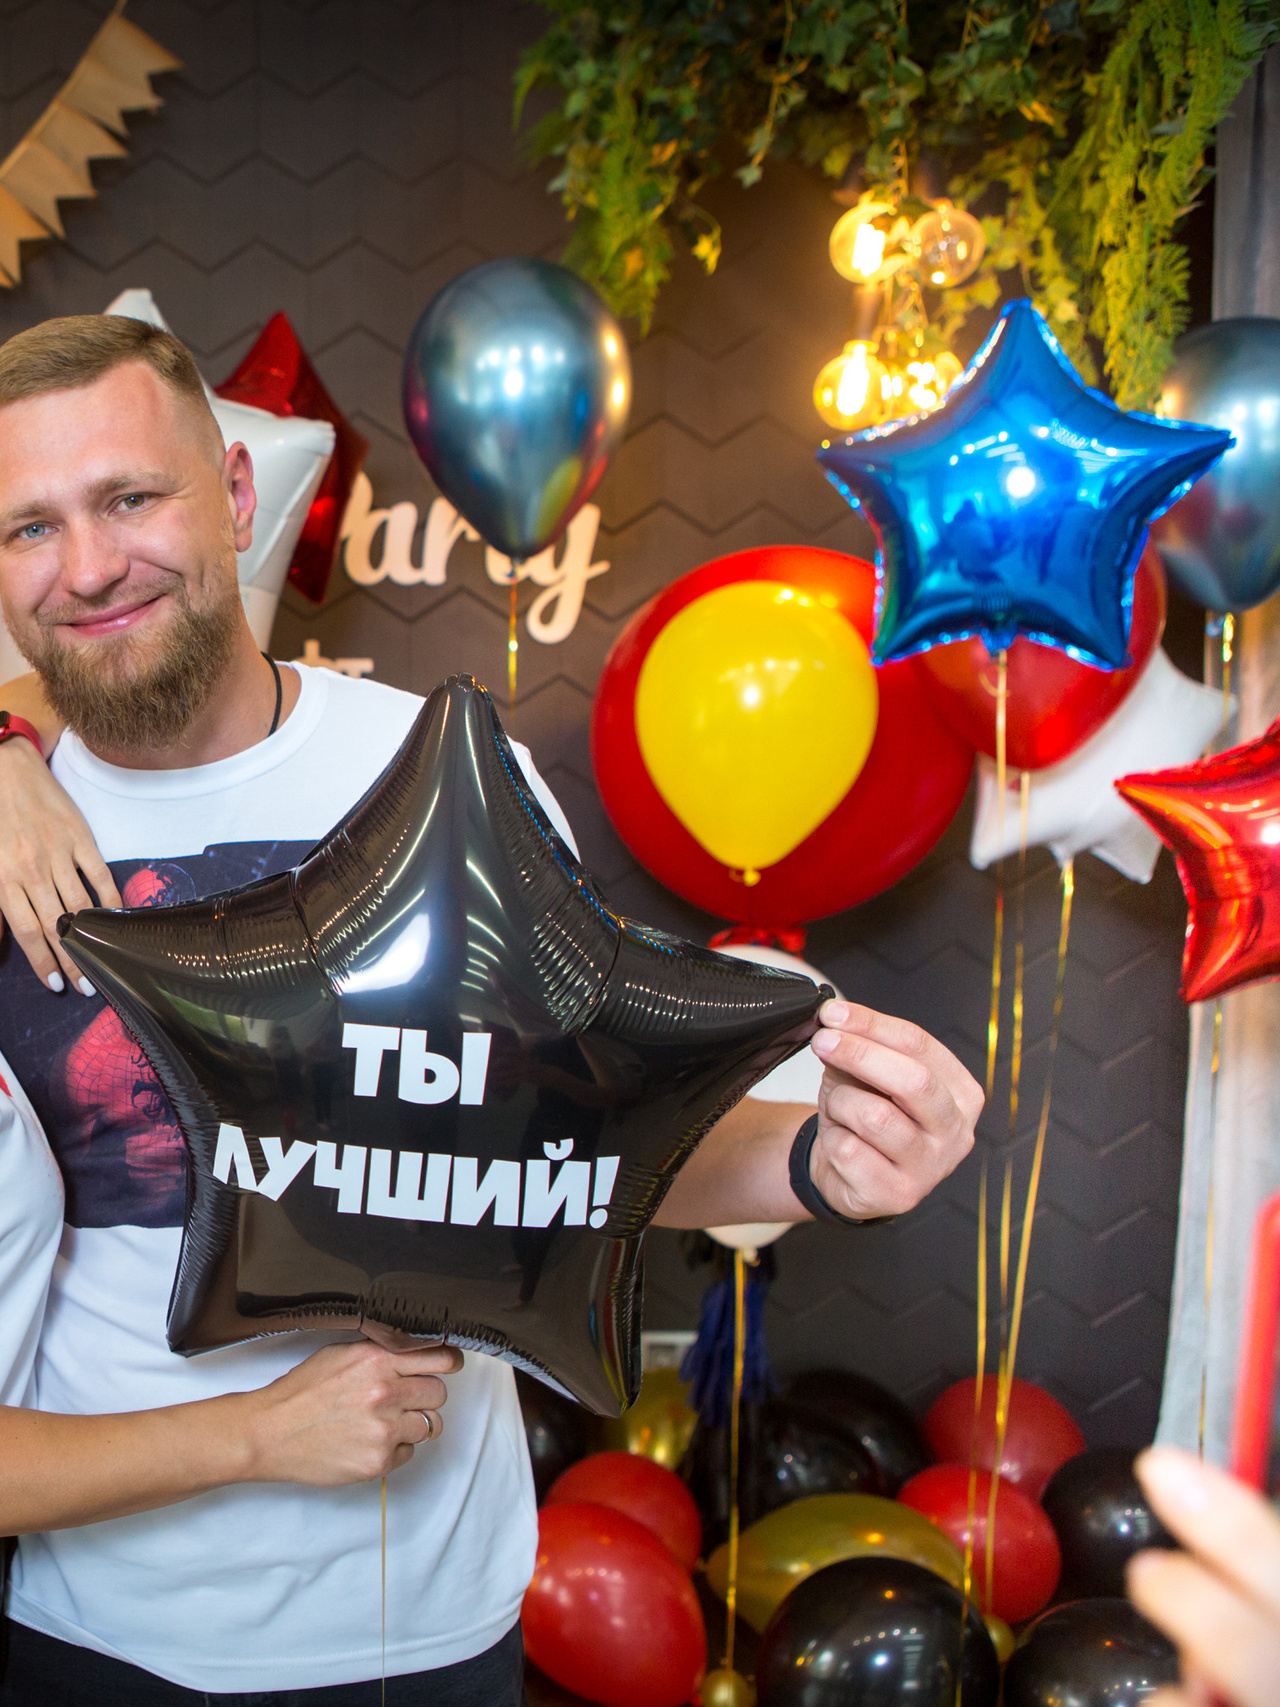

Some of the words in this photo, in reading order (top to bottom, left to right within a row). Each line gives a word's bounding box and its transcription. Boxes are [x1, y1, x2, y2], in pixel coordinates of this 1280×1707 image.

[340, 469, 611, 644] ary
[341, 1022, 493, 1106] ТЫ
[212, 1122, 621, 1230] ЛУЧШИЙ!
